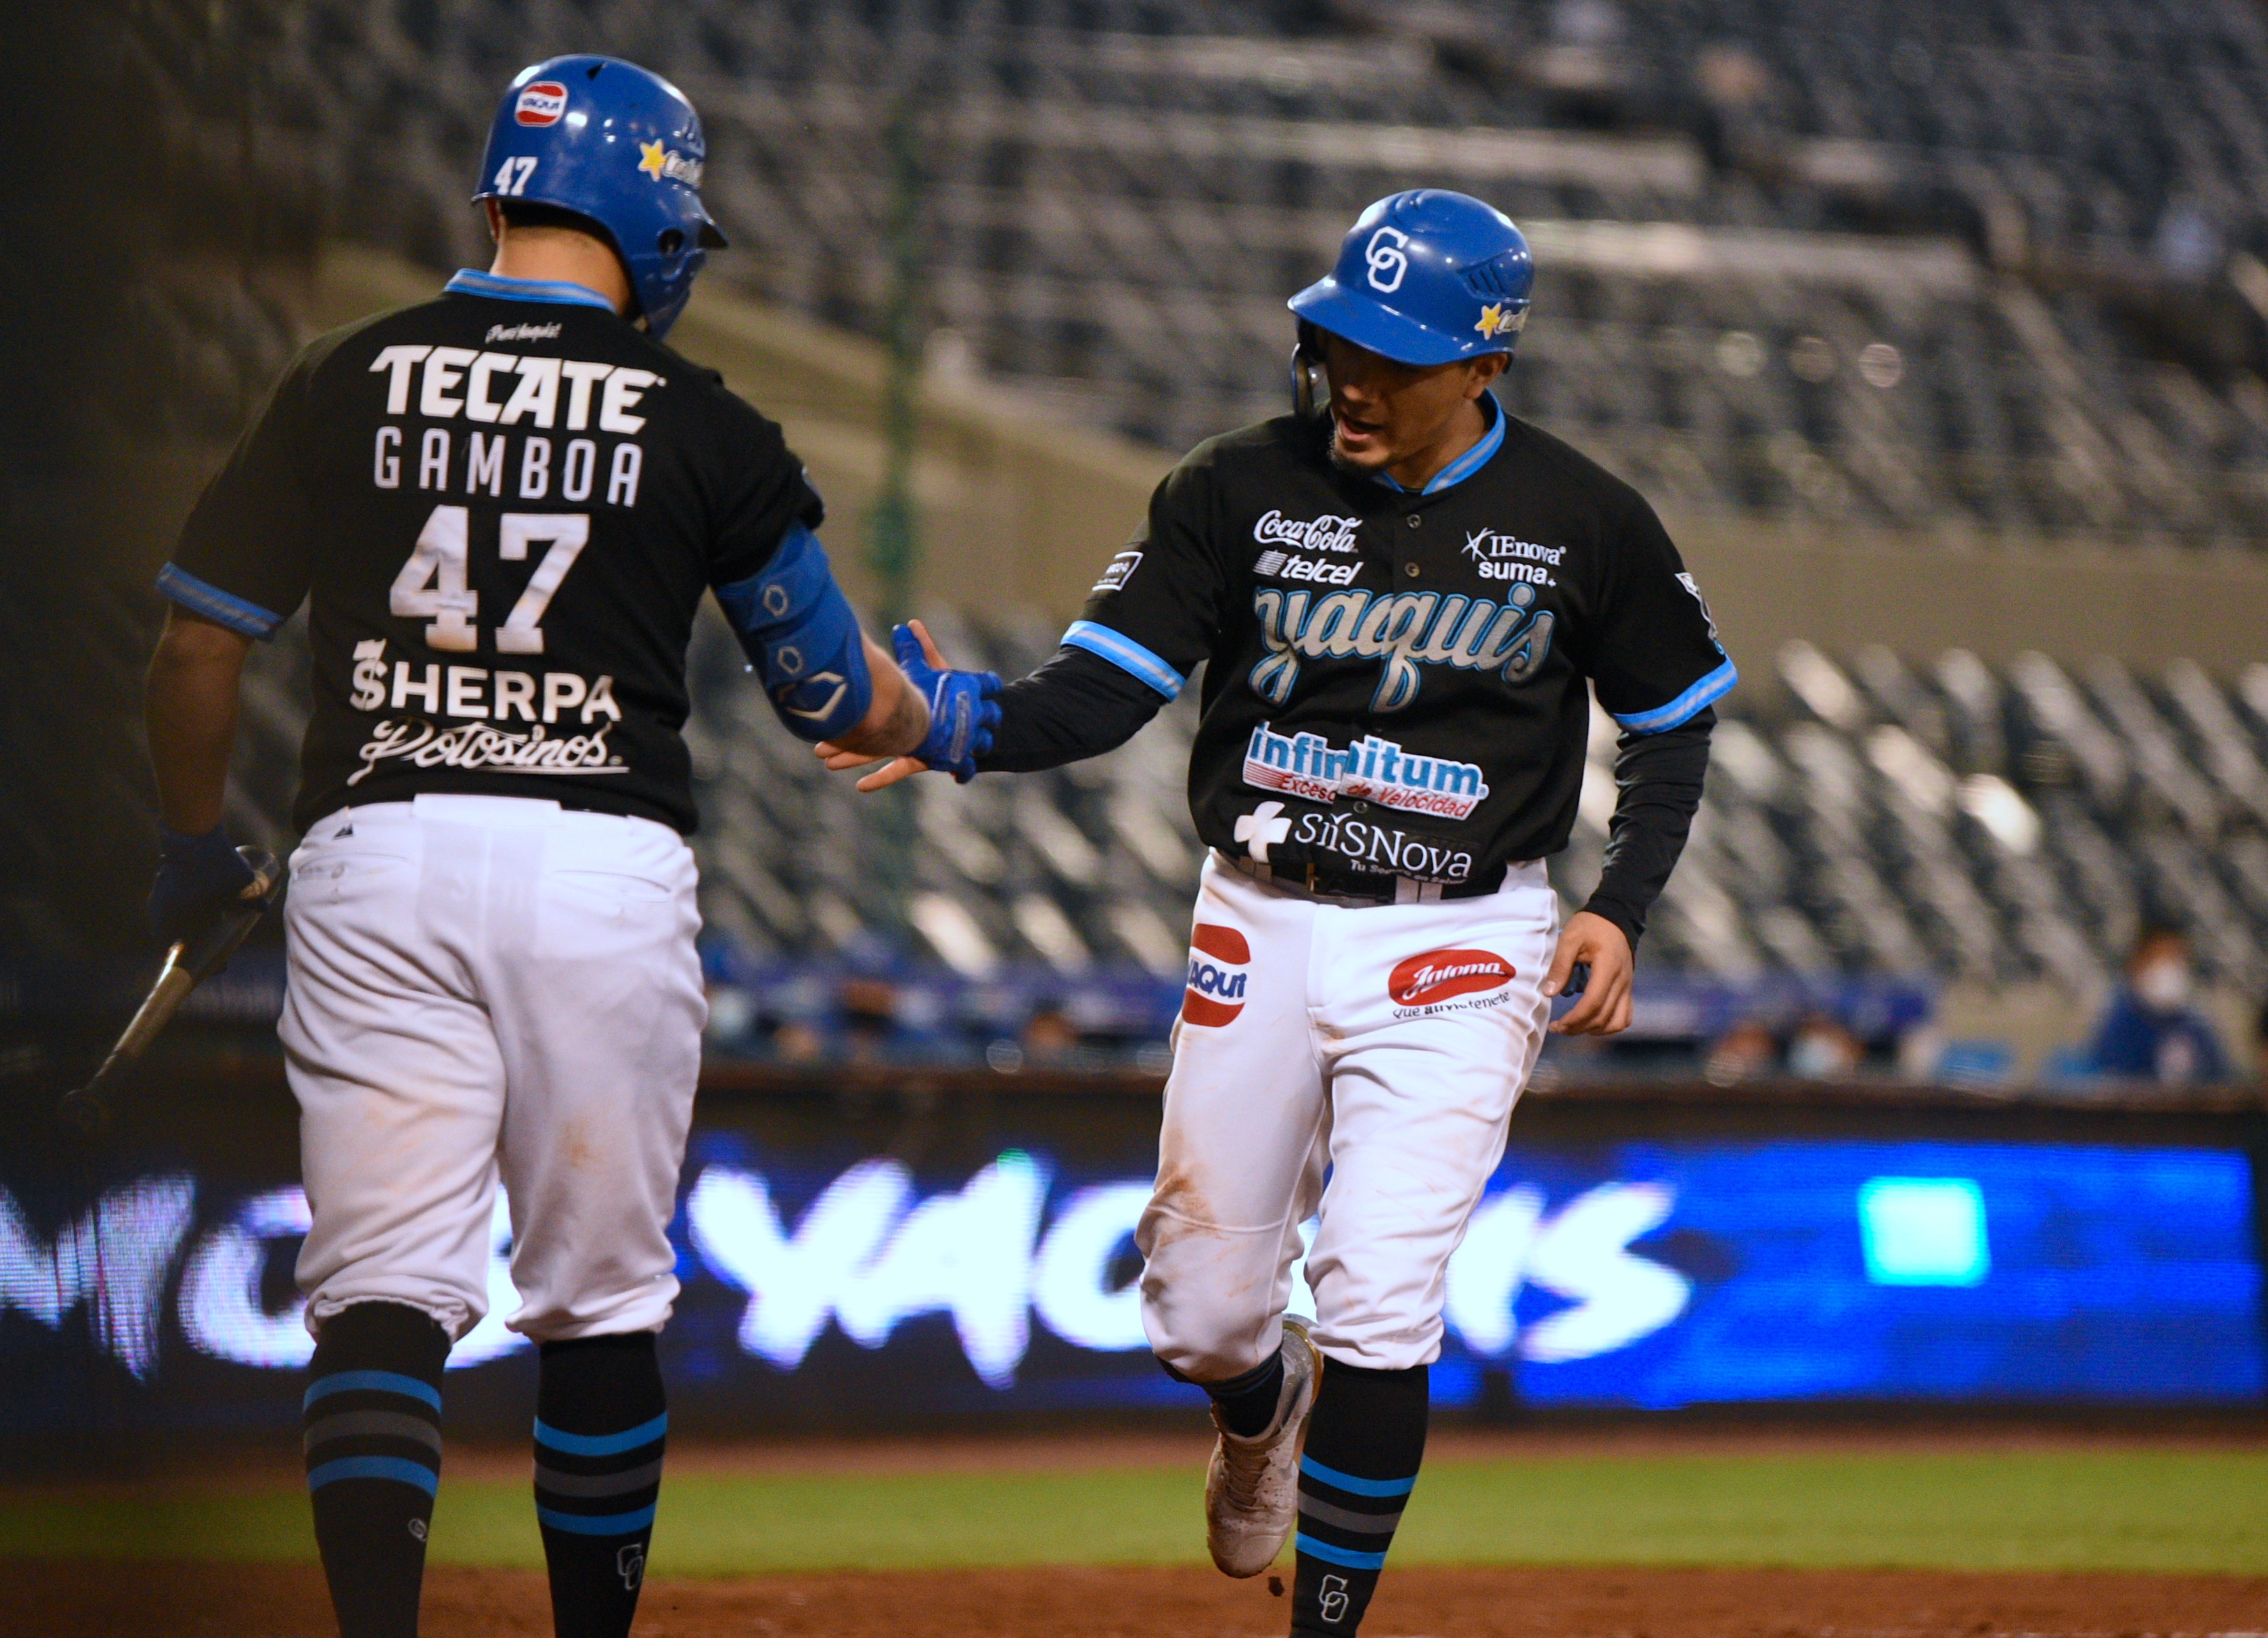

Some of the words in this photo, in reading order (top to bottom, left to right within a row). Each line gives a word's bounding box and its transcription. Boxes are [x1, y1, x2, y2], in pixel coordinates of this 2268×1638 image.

[494, 156, 538, 196] 47
[368, 344, 658, 435] TECATE
[374, 425, 643, 508] GAMBOA
[1253, 509, 1363, 552] Coca-Cola
[389, 504, 591, 655] 47
[1280, 554, 1364, 586] telcel
[349, 649, 623, 725] SHERPA
[1249, 722, 1481, 797] infinitum
[1280, 773, 1337, 802] Exceso
[1378, 787, 1473, 818] Velocidad
[1188, 958, 1247, 999] AQUI
[1402, 962, 1505, 1001] Jaloma
